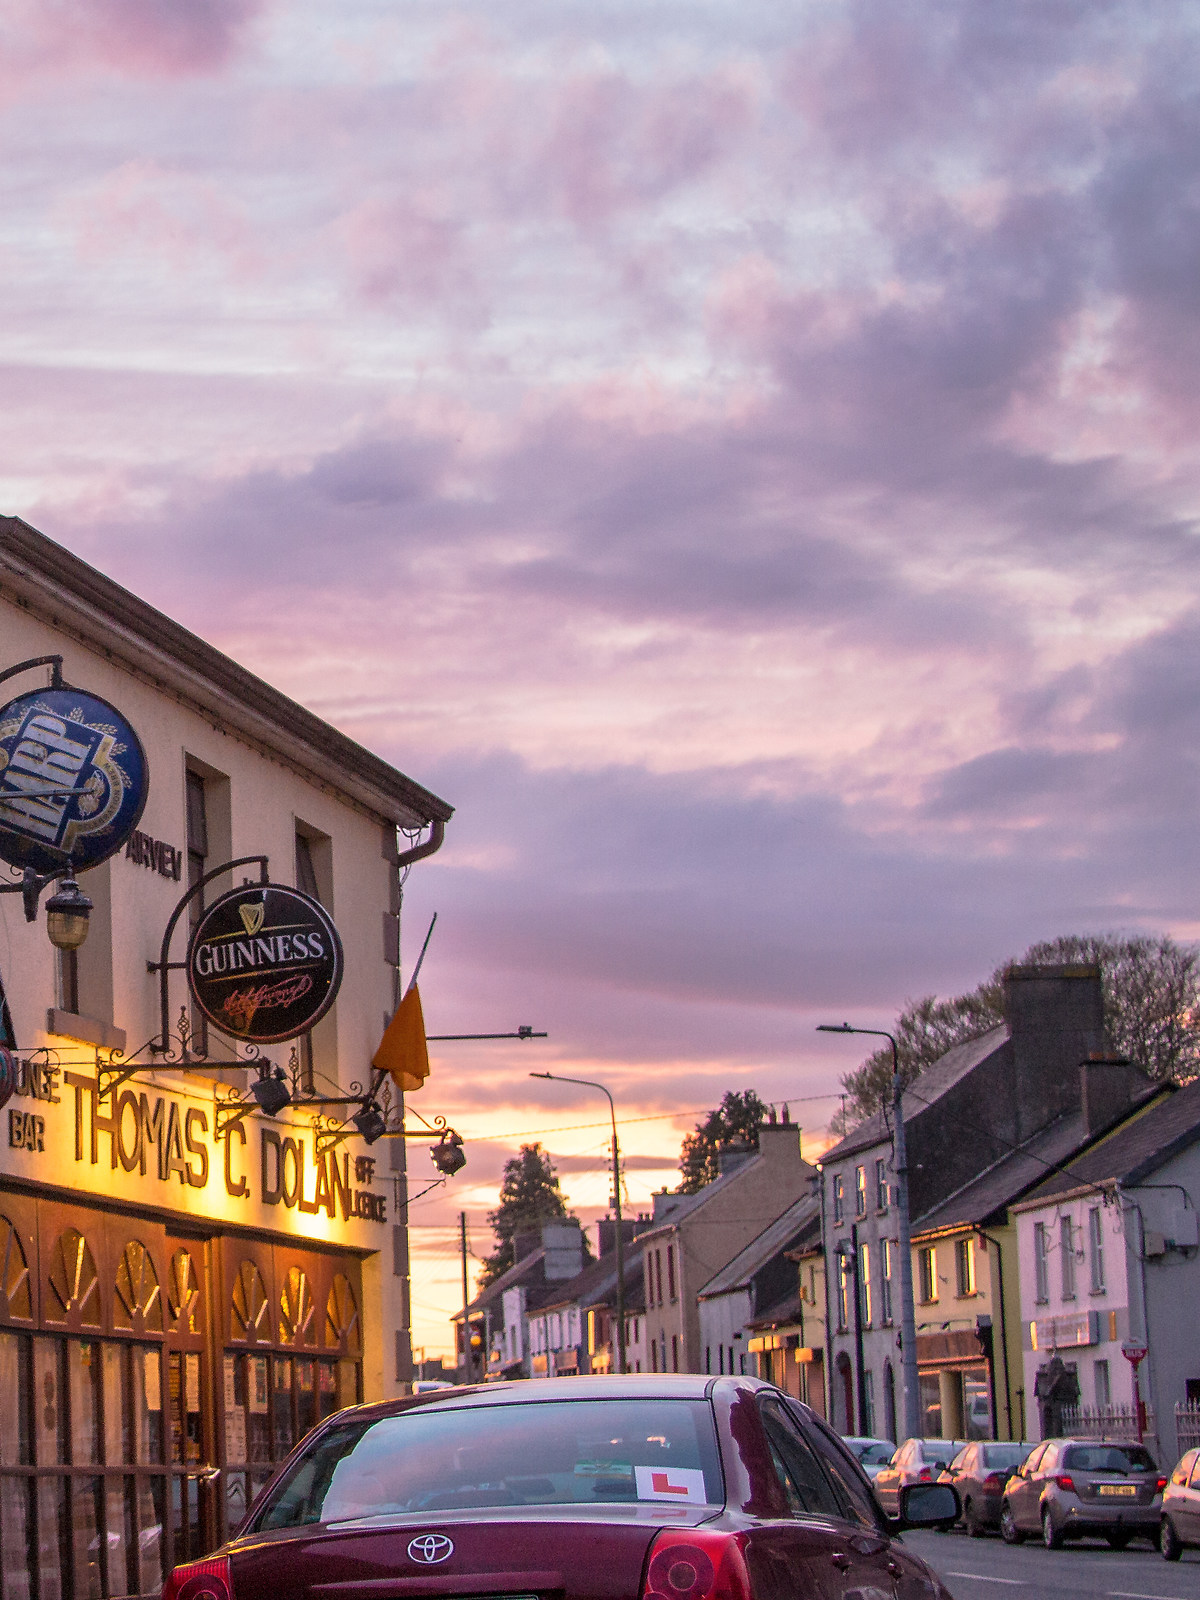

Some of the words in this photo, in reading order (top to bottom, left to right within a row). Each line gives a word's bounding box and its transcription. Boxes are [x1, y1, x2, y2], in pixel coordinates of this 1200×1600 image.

[195, 932, 325, 976] GUINNESS
[8, 1109, 45, 1152] BAR
[64, 1070, 209, 1188] THOMAS
[260, 1127, 350, 1221] DOLAN
[355, 1156, 376, 1185] OFF
[349, 1187, 387, 1223] LICENCE
[652, 1473, 688, 1495] L
